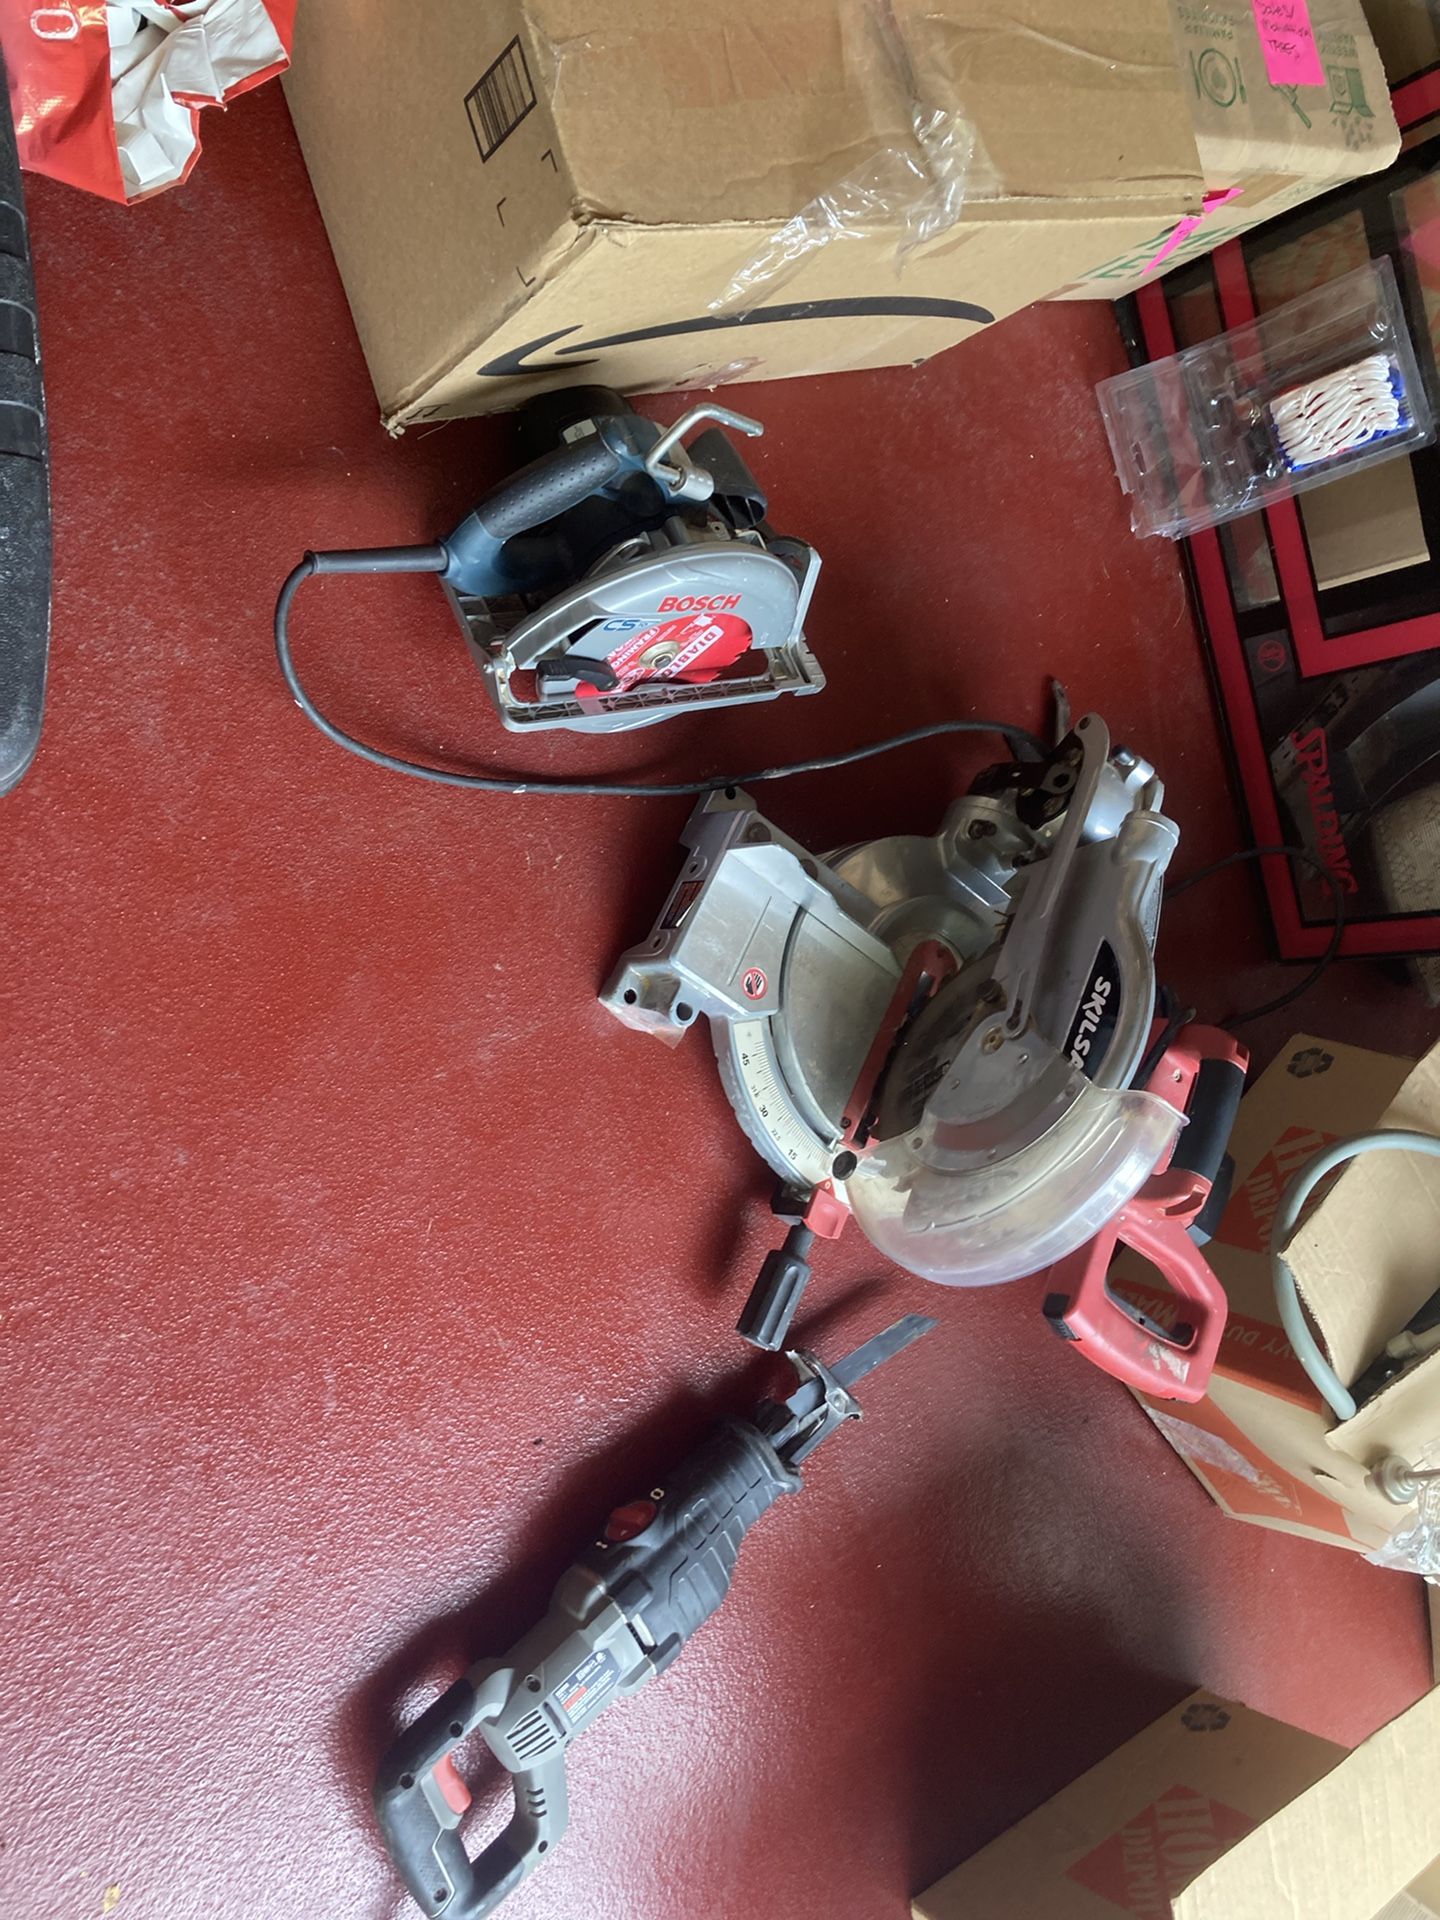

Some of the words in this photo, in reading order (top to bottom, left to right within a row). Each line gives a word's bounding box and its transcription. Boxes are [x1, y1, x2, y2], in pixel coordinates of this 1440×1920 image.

[658, 594, 741, 612] BOSCH
[661, 632, 716, 677] DIABLO
[1290, 727, 1359, 896] SPALDING
[1066, 975, 1112, 1074] SKILSA
[741, 1052, 750, 1067] 45
[758, 1104, 769, 1118] 30
[787, 1148, 798, 1161] 15
